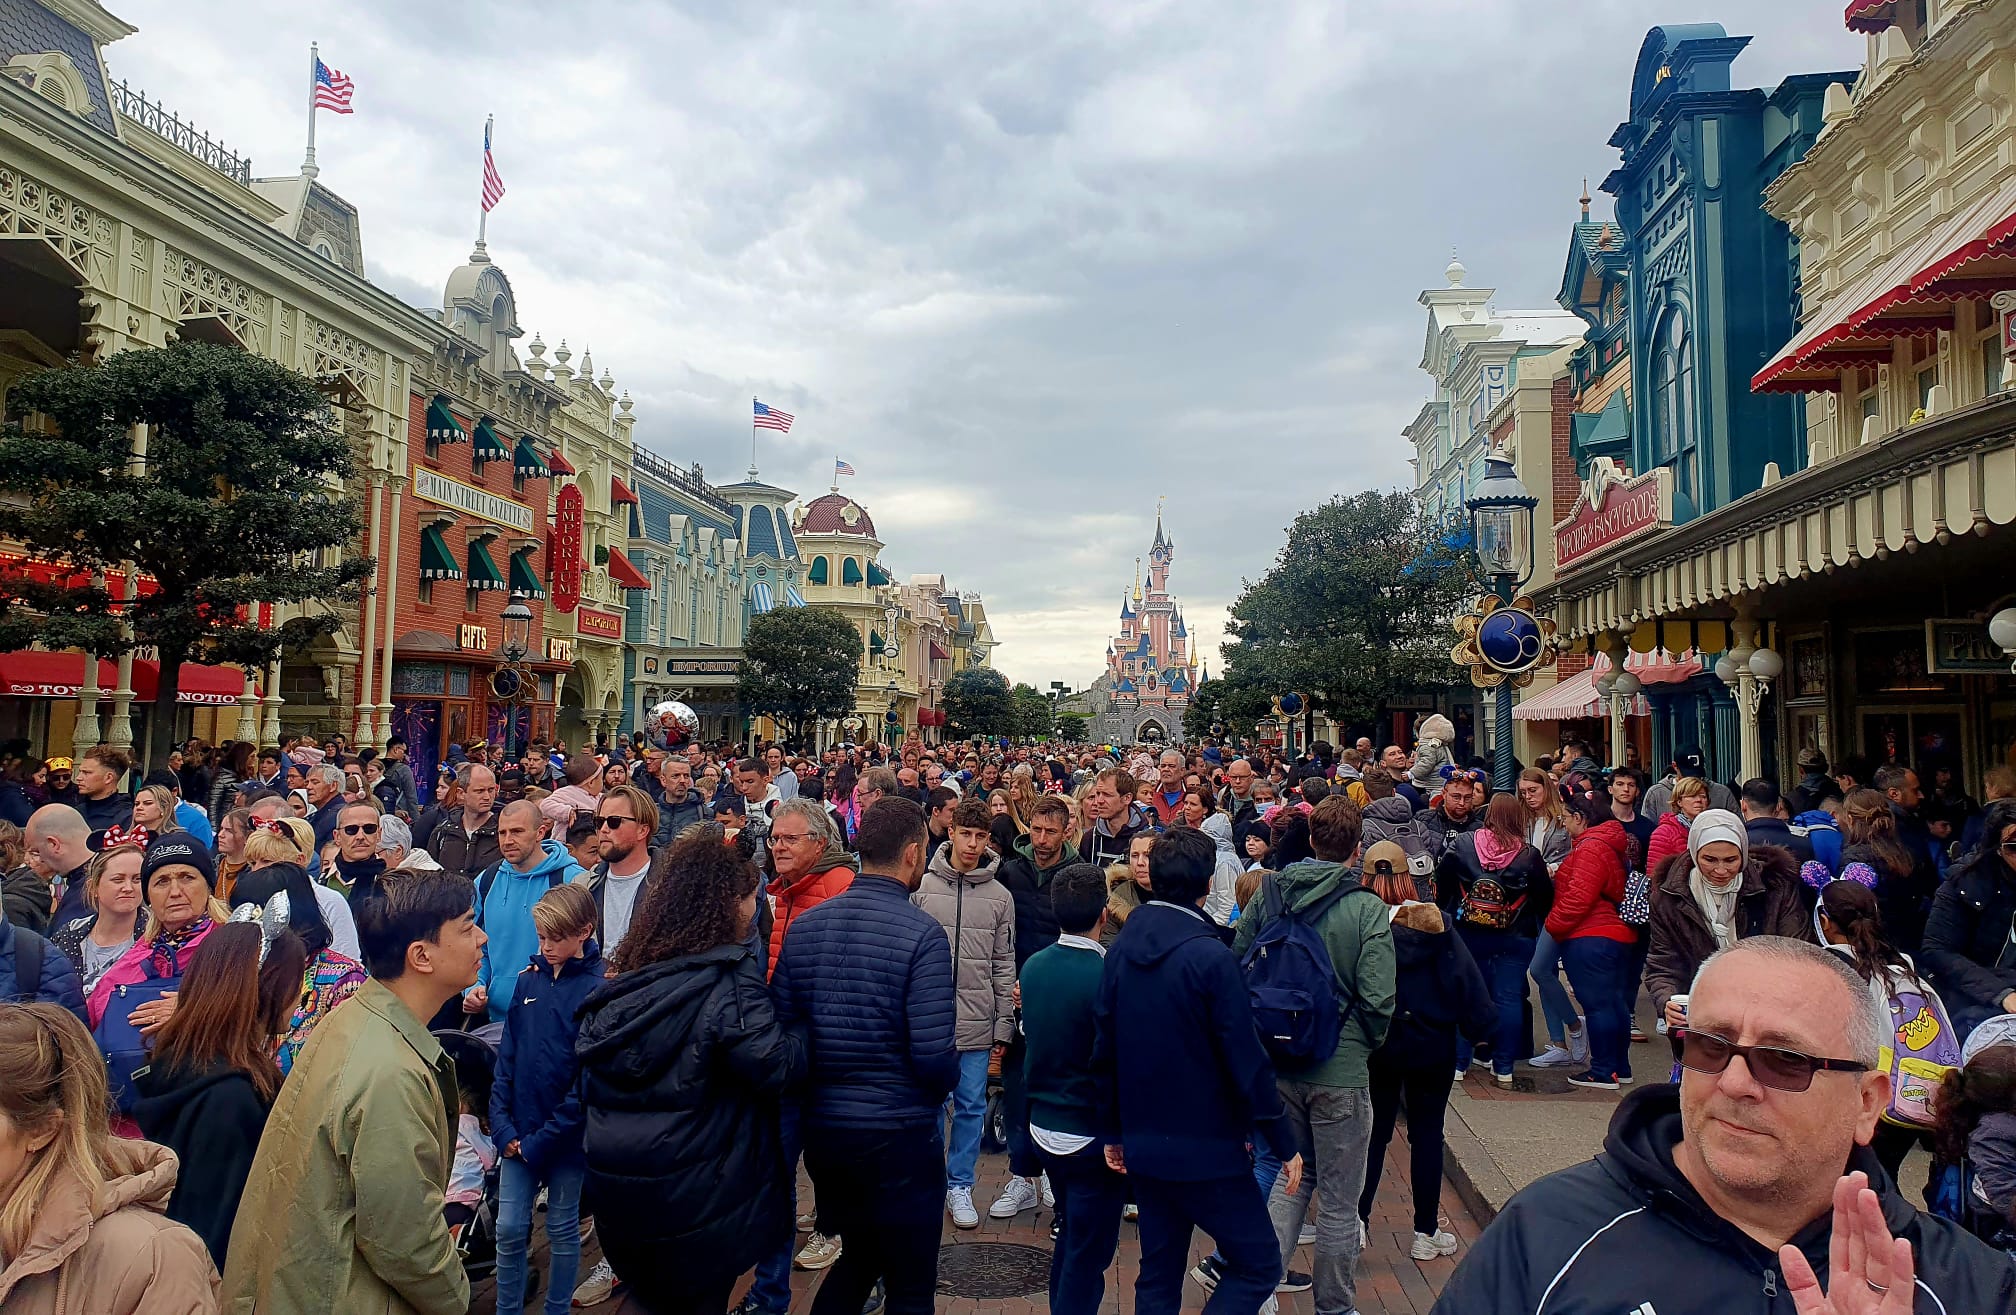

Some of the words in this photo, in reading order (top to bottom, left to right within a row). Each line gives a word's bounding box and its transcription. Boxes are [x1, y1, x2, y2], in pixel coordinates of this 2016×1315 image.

[429, 476, 453, 503] MAIN
[455, 484, 486, 514] STREET
[489, 497, 522, 526] GAZETTE
[1558, 523, 1587, 560] IMPORTS
[1594, 504, 1621, 542] FANCY
[1622, 485, 1657, 529] GOODS
[558, 499, 576, 595] EMPORIUM
[461, 624, 487, 650] GIFTS
[551, 637, 571, 661] GIFTS
[671, 661, 740, 672] EMPORIUM
[38, 684, 83, 695] TOY
[176, 691, 239, 704] NOTIO
